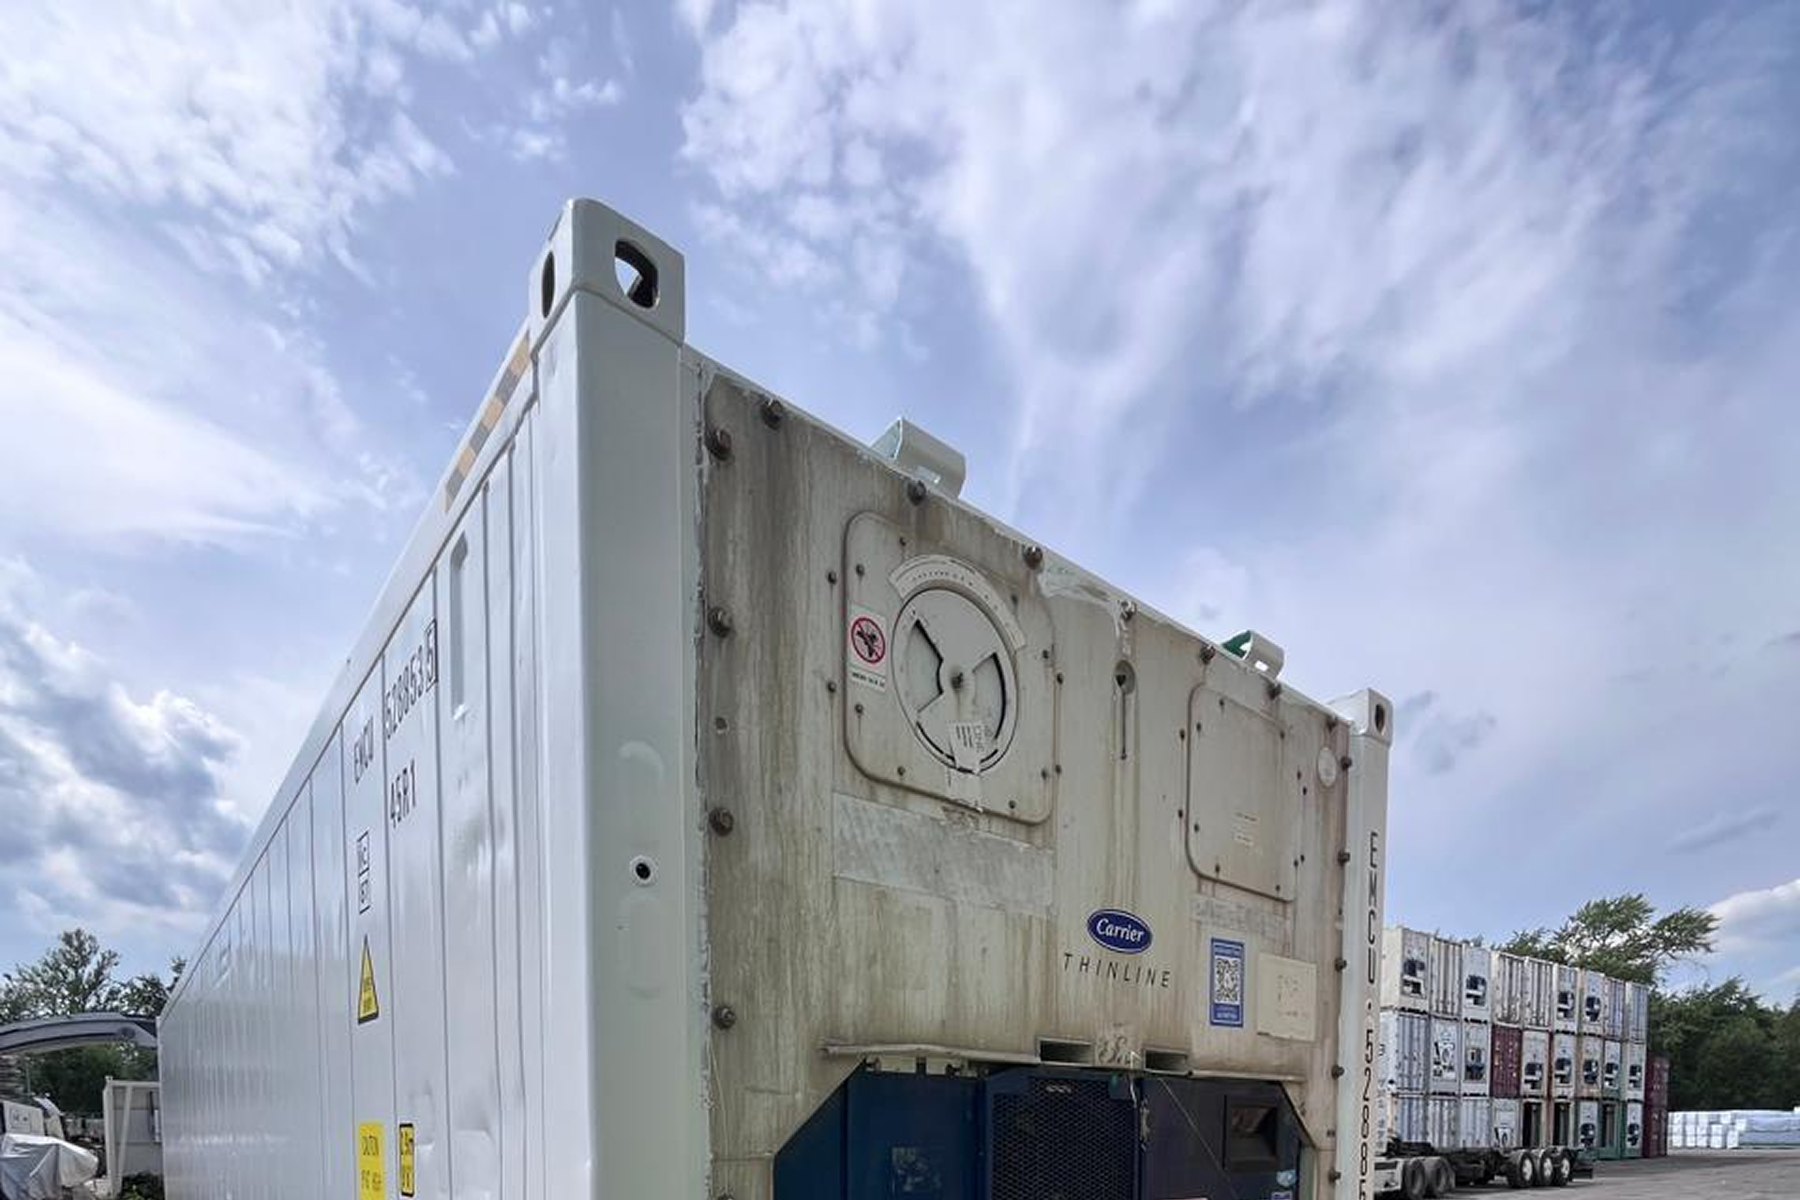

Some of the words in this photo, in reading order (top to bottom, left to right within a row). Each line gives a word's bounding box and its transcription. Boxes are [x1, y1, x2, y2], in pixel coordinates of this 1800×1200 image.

[390, 758, 416, 829] 45R1
[1096, 918, 1145, 942] Carrier
[1064, 952, 1171, 988] THINLINE
